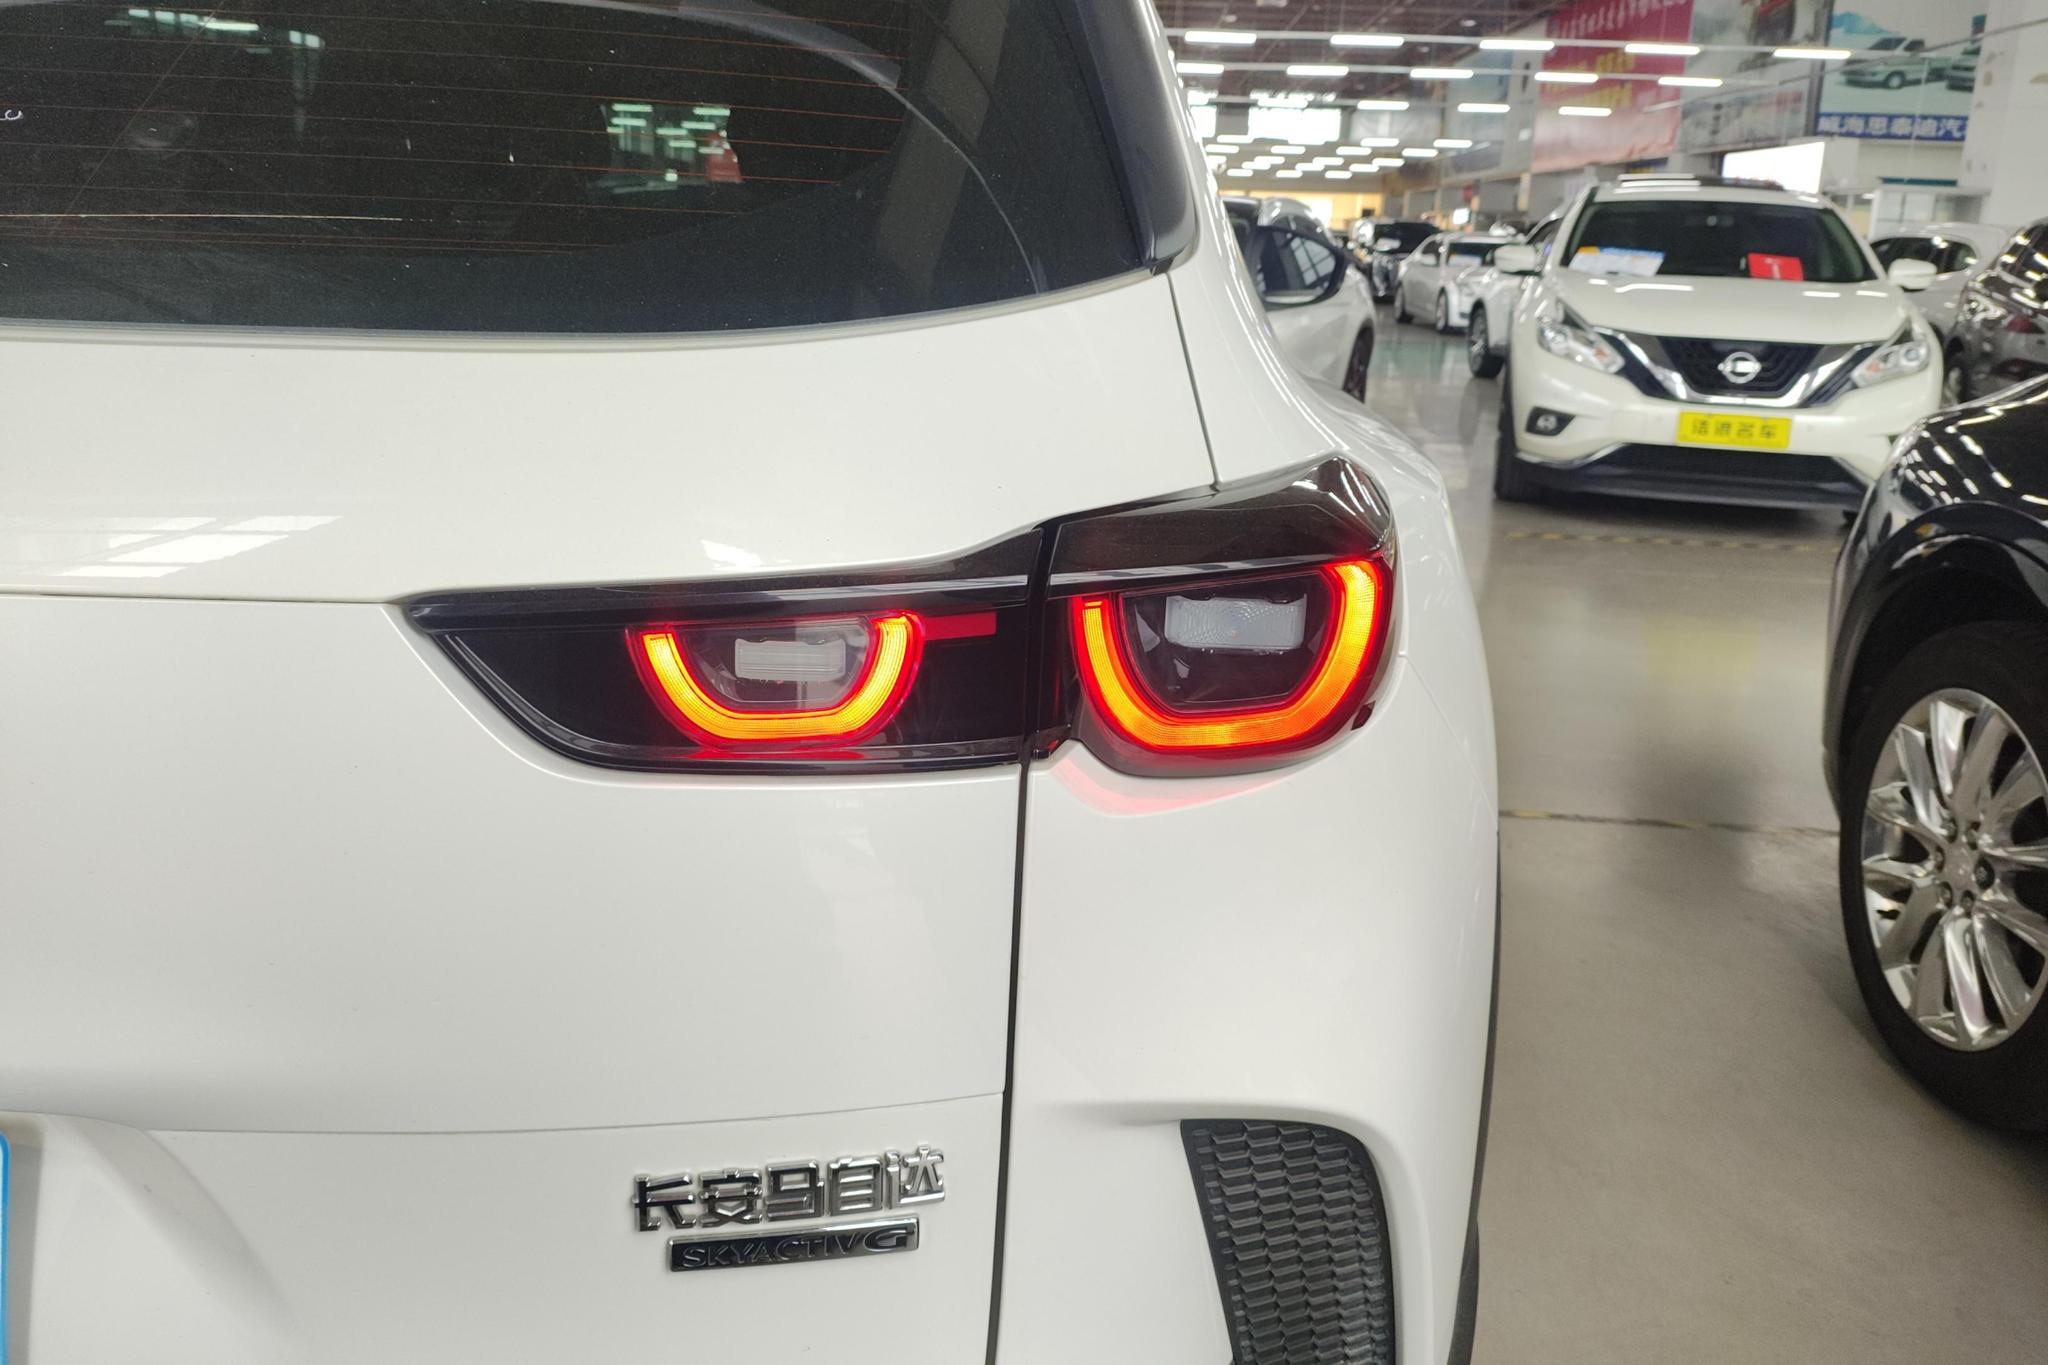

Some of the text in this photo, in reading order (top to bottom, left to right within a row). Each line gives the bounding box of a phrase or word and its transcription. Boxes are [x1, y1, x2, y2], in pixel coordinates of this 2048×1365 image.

[632, 1144, 945, 1232] 长安马自达
[682, 1234, 860, 1268] SKYACTIV
